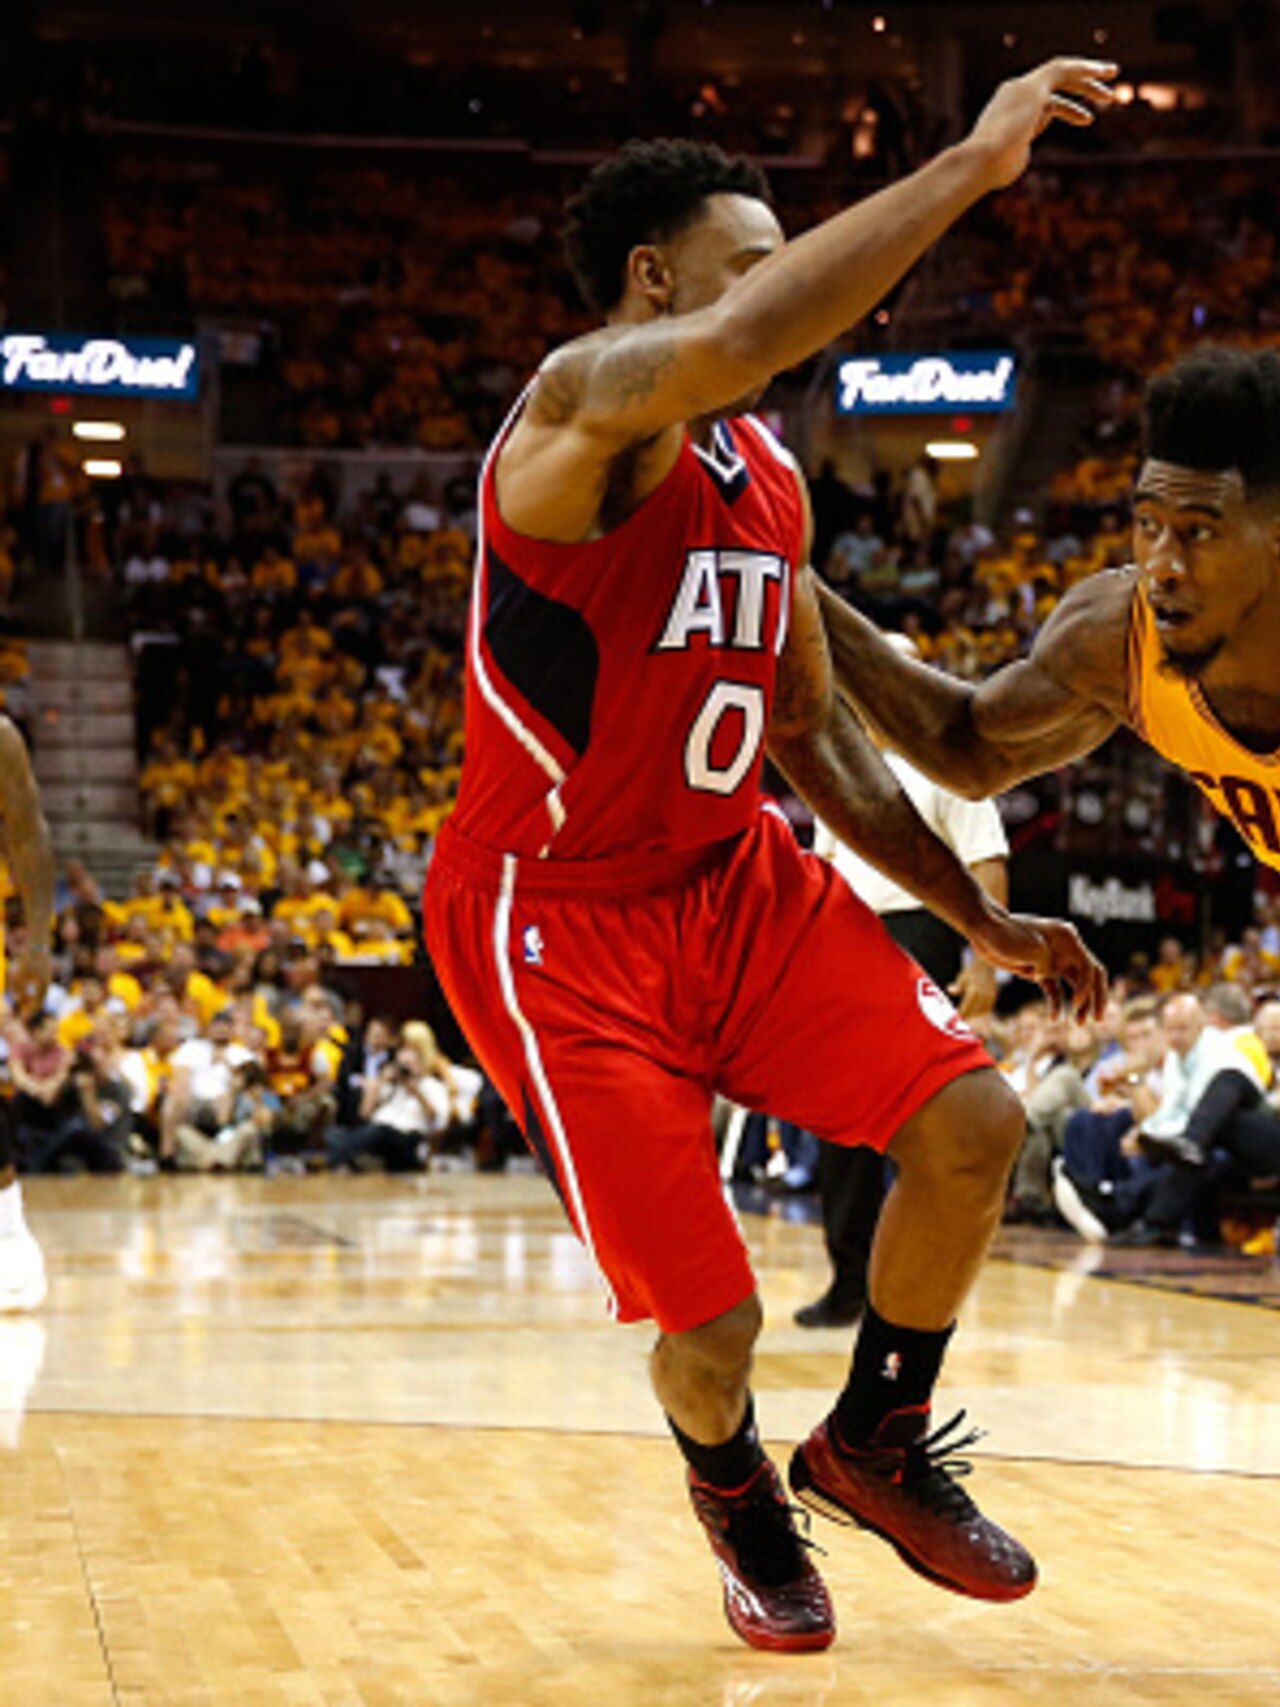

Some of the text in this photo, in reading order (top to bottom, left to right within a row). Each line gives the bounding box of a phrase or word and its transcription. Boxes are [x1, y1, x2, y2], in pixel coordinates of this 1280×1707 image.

[1, 335, 195, 389] FanDuel
[839, 357, 1013, 410] FanDuel
[683, 676, 765, 795] 0
